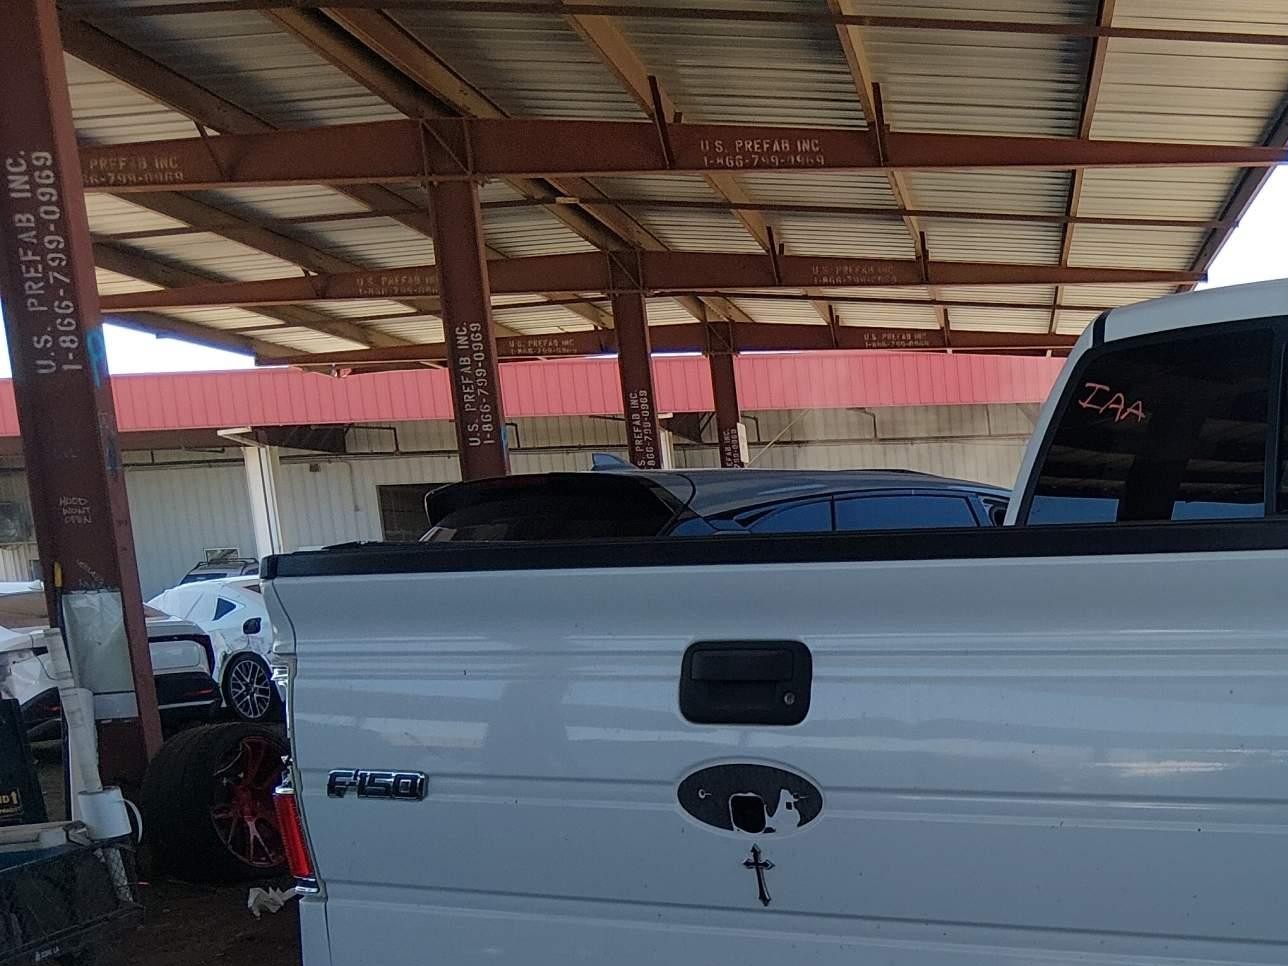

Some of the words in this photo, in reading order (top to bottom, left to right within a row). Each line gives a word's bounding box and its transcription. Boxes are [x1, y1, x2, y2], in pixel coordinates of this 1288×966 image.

[89, 158, 147, 170] PREFB
[735, 139, 790, 153] PREFAB
[6, 150, 32, 199] INC.
[14, 212, 49, 312] PREFAB
[31, 151, 83, 371] 1-866-799-0969
[34, 327, 56, 374] U.S.
[459, 356, 477, 412] PREFAB
[469, 322, 496, 444] 1-866-799-0969
[1079, 382, 1146, 422] IAA
[632, 413, 645, 452] PREFAB
